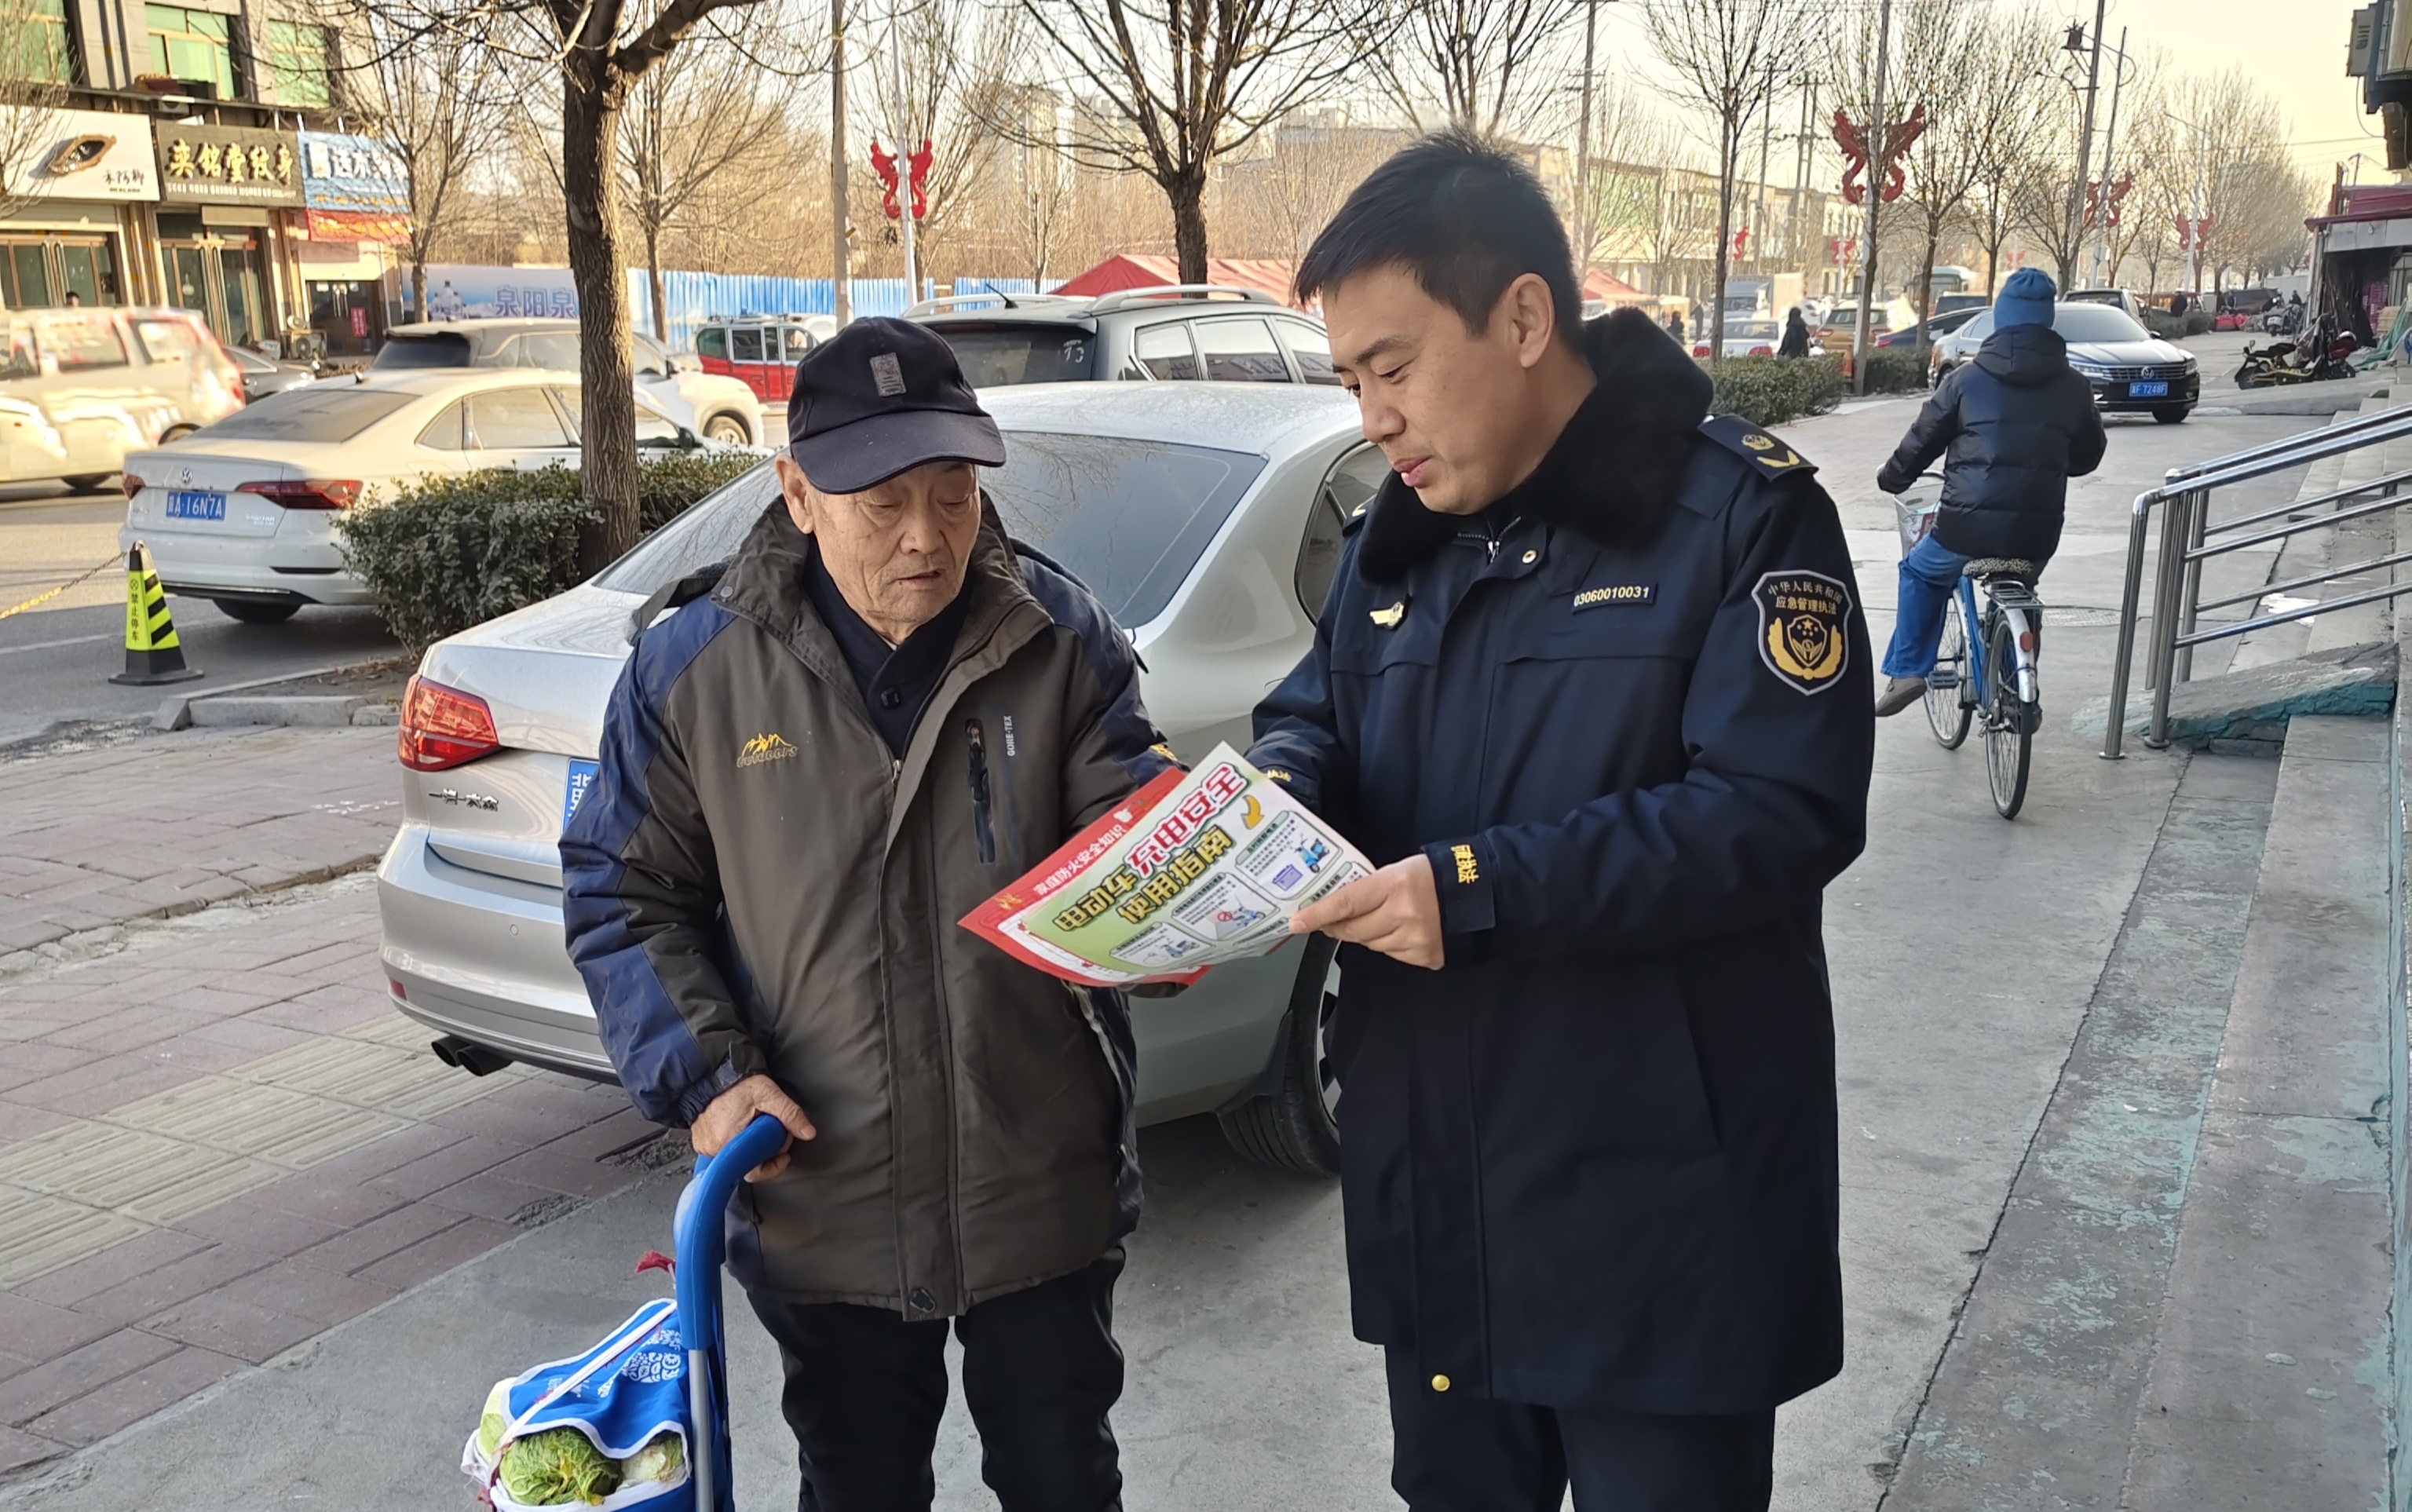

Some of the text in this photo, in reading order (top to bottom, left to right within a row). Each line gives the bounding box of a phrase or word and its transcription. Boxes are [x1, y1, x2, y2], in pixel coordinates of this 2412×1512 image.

[495, 286, 577, 319] 泉阳泉
[1573, 586, 1650, 607] 03060010031
[1768, 580, 1844, 604] 中华人民共和国
[1775, 595, 1837, 615] 应急管理执法
[130, 593, 140, 643] 禁止停车
[1032, 824, 1127, 896] 家庭防火安全知识
[1054, 865, 1138, 931] 电动车
[1125, 762, 1247, 878] 充电安全
[1116, 825, 1233, 924] 使用指南
